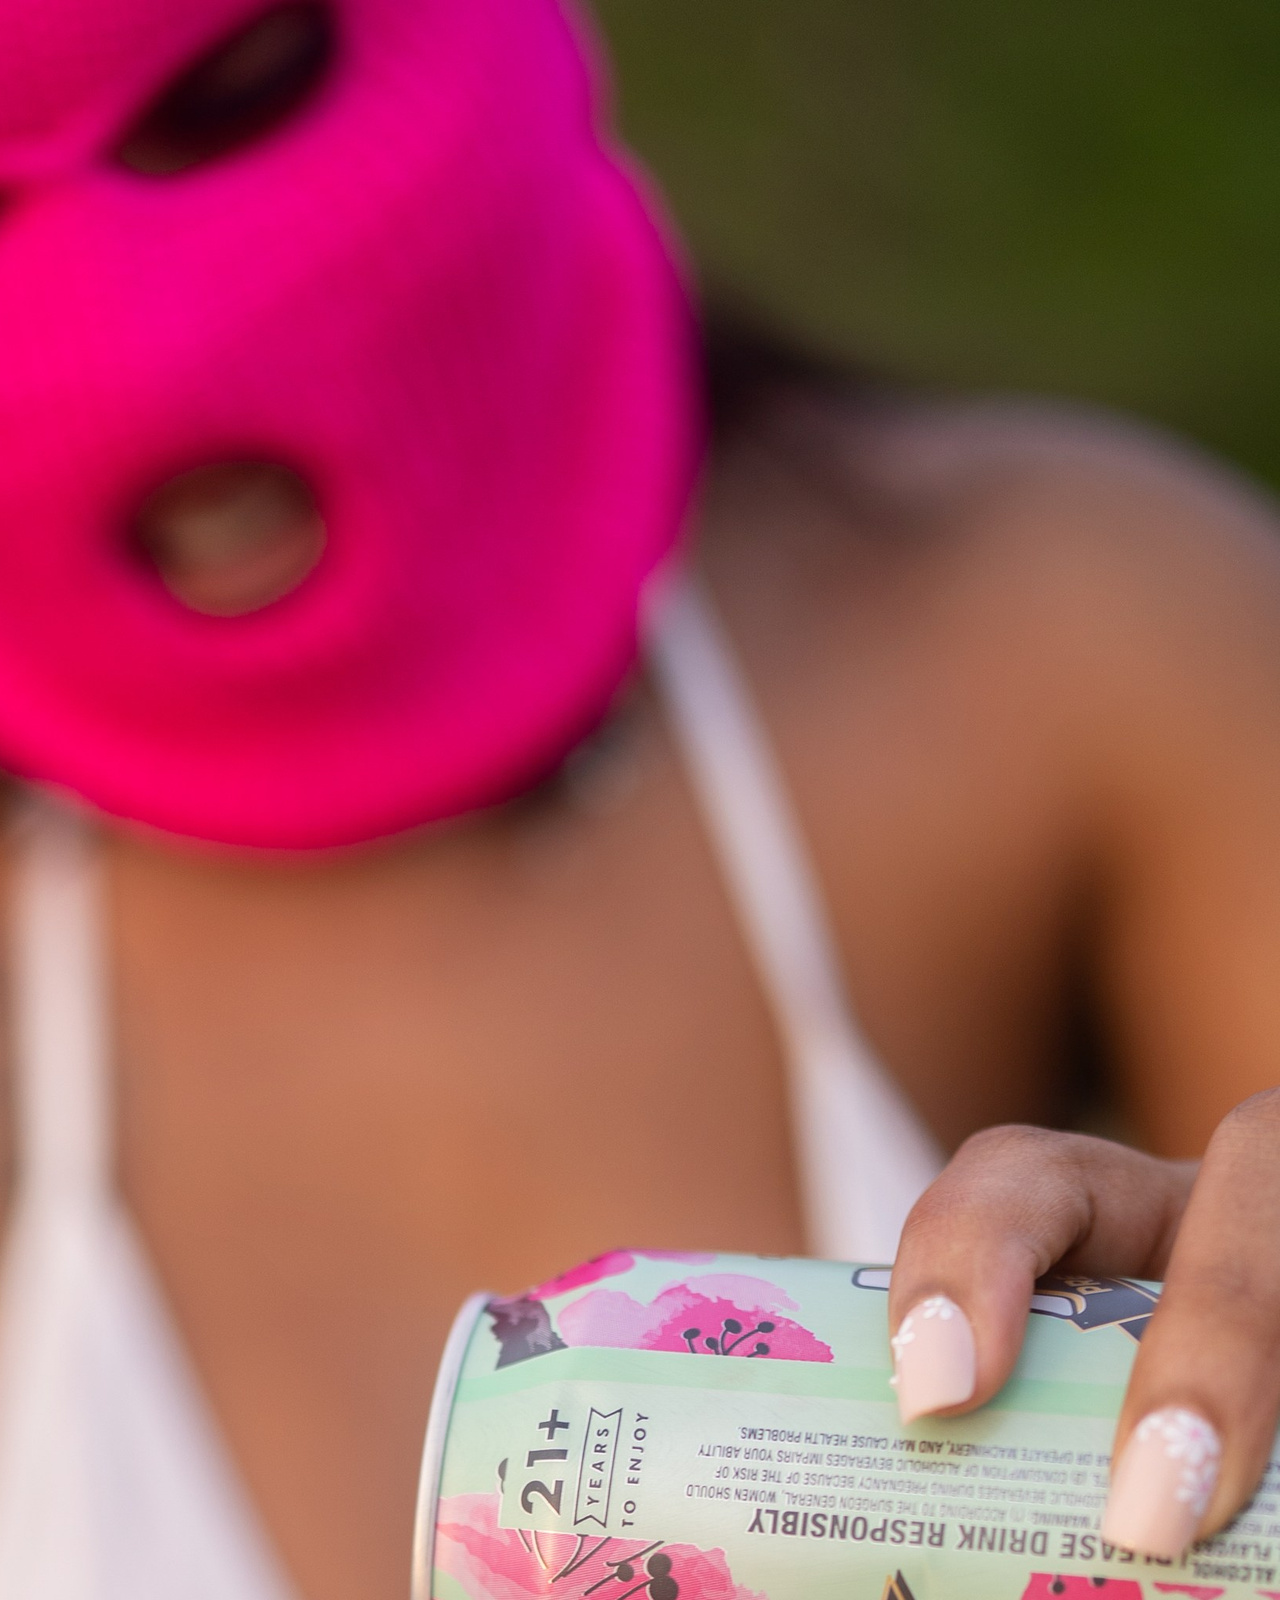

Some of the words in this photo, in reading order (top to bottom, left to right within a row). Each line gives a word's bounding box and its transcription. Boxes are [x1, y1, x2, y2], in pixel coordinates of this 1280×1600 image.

[738, 1426, 802, 1444] PROBLEMS.
[804, 1432, 848, 1447] HEALTH
[851, 1435, 888, 1450] CAUSE
[626, 1412, 649, 1484] ENJOY
[697, 1444, 742, 1459] ABILITY
[891, 1438, 916, 1452] MAY
[918, 1440, 943, 1454] AND
[946, 1440, 1018, 1462] MACHINERY,
[520, 1409, 570, 1516] 21+
[744, 1447, 773, 1462] YOUR
[776, 1449, 823, 1464] IMPAIRS
[825, 1453, 893, 1472] BEVERAGES
[1021, 1449, 1074, 1464] OPERATE
[587, 1428, 610, 1506] YEARS
[714, 1466, 730, 1479] OF
[732, 1467, 758, 1481] RISK
[894, 1457, 960, 1474] ALCOHOLIC
[962, 1465, 979, 1479] OF
[762, 1470, 782, 1483] THE
[786, 1472, 800, 1485] OF
[804, 1472, 855, 1488] BECAUSE
[981, 1465, 1067, 1485] CONSUMPTION
[685, 1484, 731, 1501] SHOULD
[734, 1487, 777, 1504] WOMEN
[858, 1476, 928, 1498] PREGNANCY
[930, 1482, 974, 1500] DURING
[978, 1485, 1046, 1504] BEVERAGES
[780, 1489, 836, 1508] GENERAL,
[839, 1496, 893, 1510] SURGEON
[1049, 1491, 1108, 1508] LCOHOLIC
[622, 1500, 636, 1527] TO
[897, 1501, 918, 1516] THE
[922, 1503, 936, 1517] TO
[940, 1504, 1006, 1523] ACCORDING
[747, 1508, 945, 1547] RESPONSIBLY
[955, 1524, 1048, 1557] DRINK
[1058, 1533, 1173, 1567] EASE
